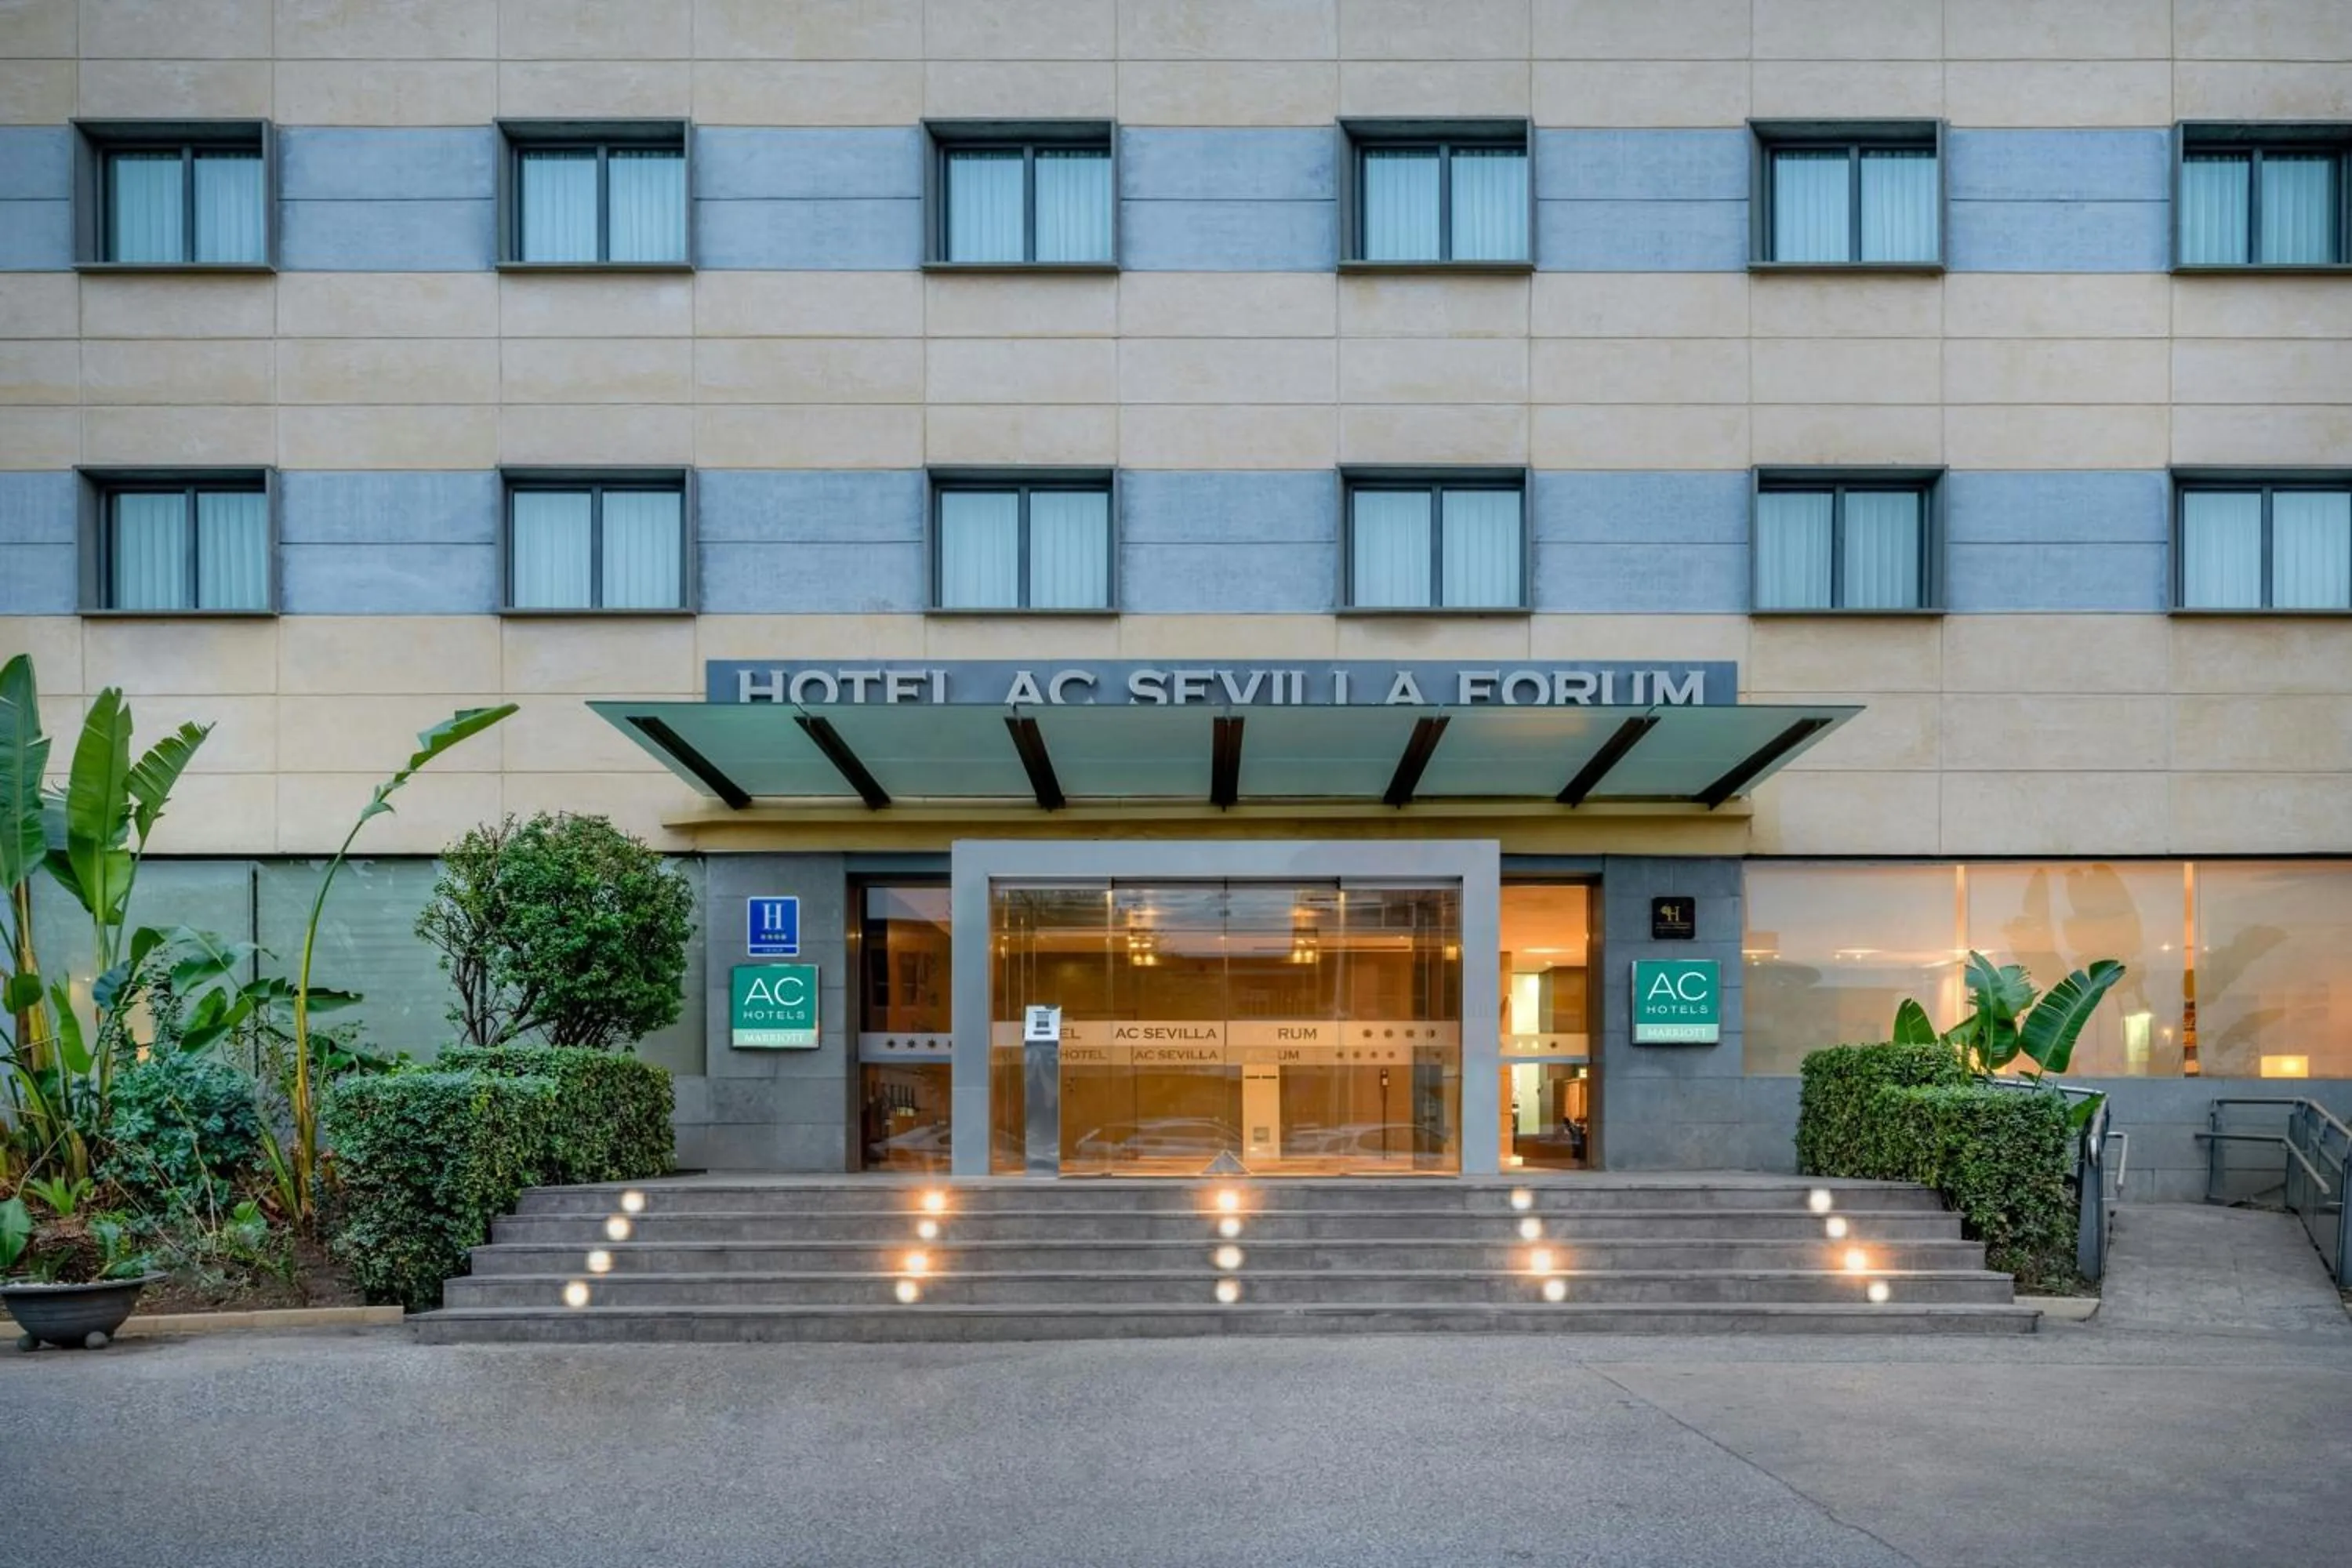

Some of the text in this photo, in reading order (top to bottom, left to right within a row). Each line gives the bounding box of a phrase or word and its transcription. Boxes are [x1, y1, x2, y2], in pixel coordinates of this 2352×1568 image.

[738, 670, 950, 704] HOTEL
[1005, 670, 1096, 704] AC
[1457, 670, 1706, 704] FORUM
[762, 903, 783, 930] H
[1647, 971, 1708, 1001] AC
[744, 977, 804, 1006] AC
[1646, 1004, 1708, 1014] HOTELS
[743, 1011, 805, 1020] HOTELS
[1116, 1028, 1139, 1039] AC
[1142, 1028, 1217, 1039] SEVILLA
[1647, 1028, 1706, 1037] MARRIOTT
[744, 1033, 804, 1043] MARRIOTT
[1134, 1050, 1155, 1060] AC
[1158, 1050, 1218, 1060] SEVILLA
